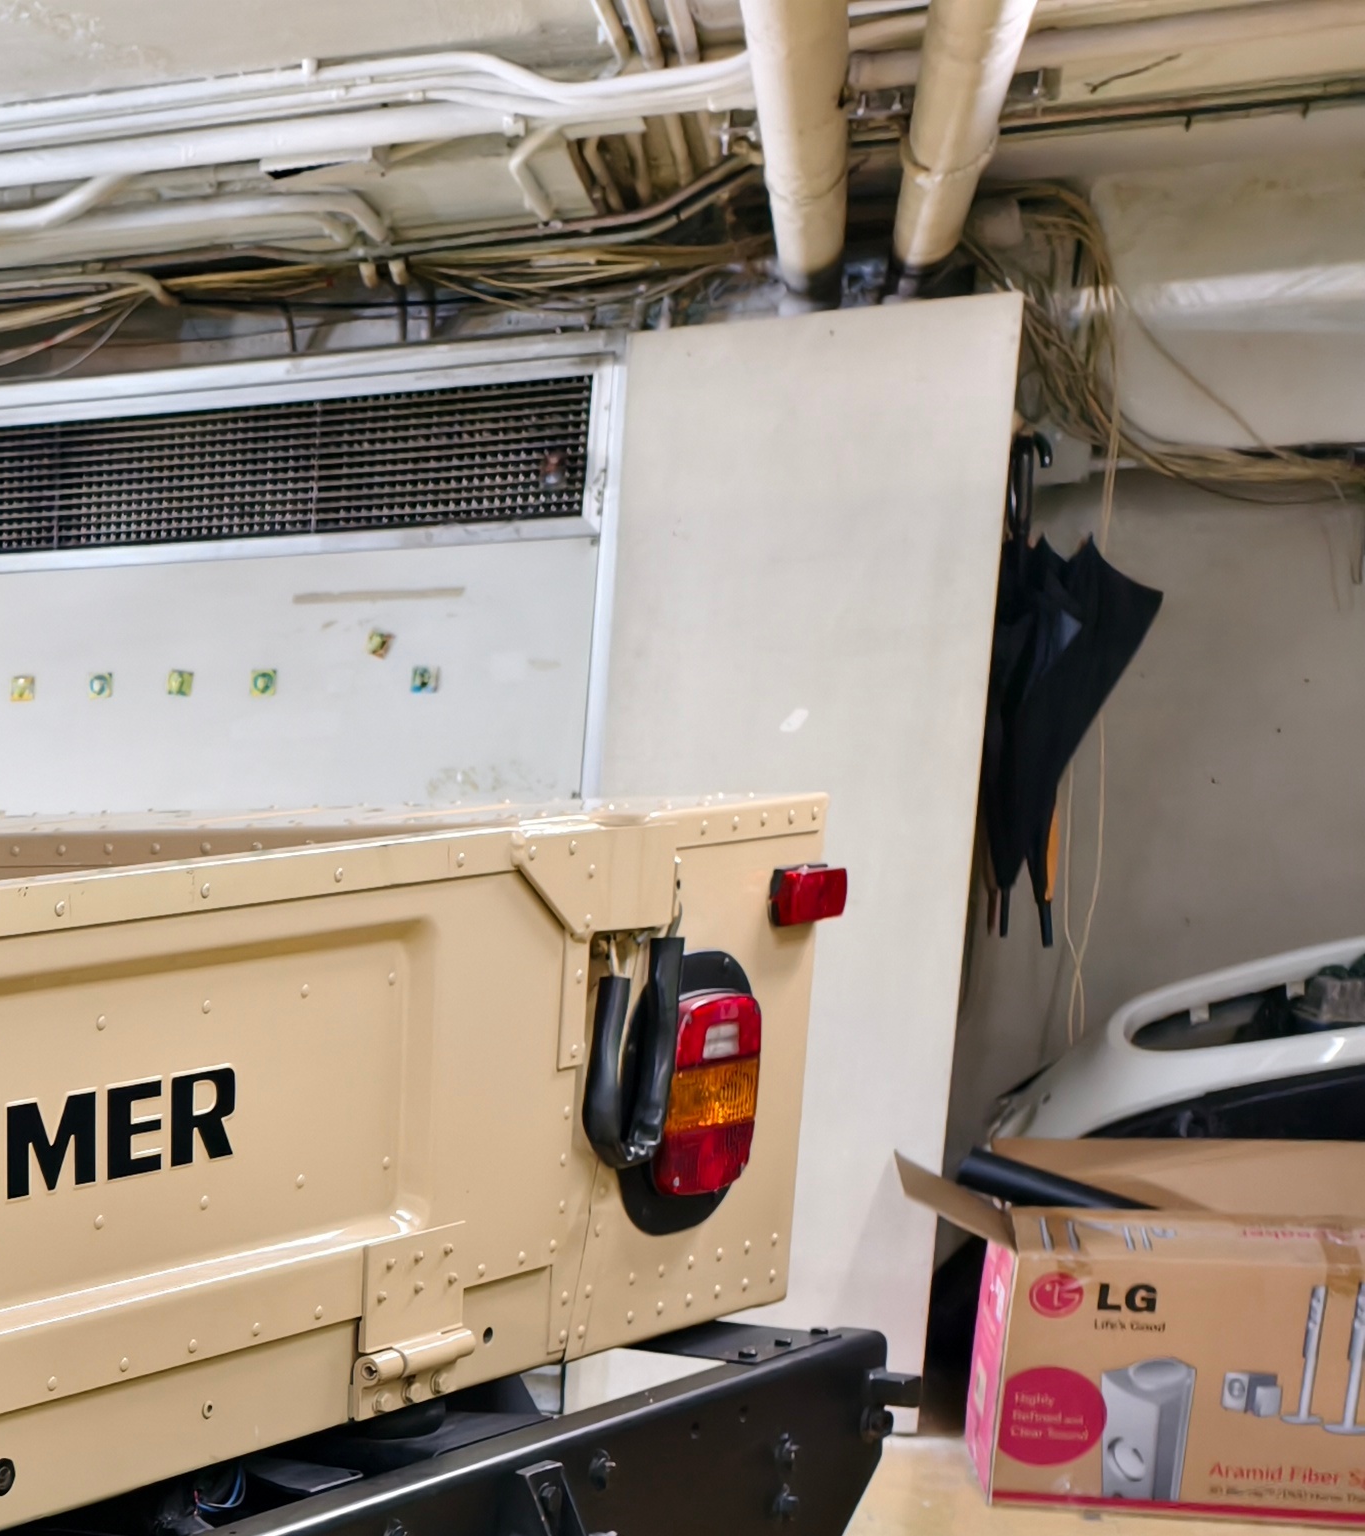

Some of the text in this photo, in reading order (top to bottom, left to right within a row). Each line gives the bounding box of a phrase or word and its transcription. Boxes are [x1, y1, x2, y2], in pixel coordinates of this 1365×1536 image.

[1096, 1282, 1158, 1314] LG
[1209, 1461, 1283, 1482] Aramid
[1289, 1465, 1341, 1485] Fiber
